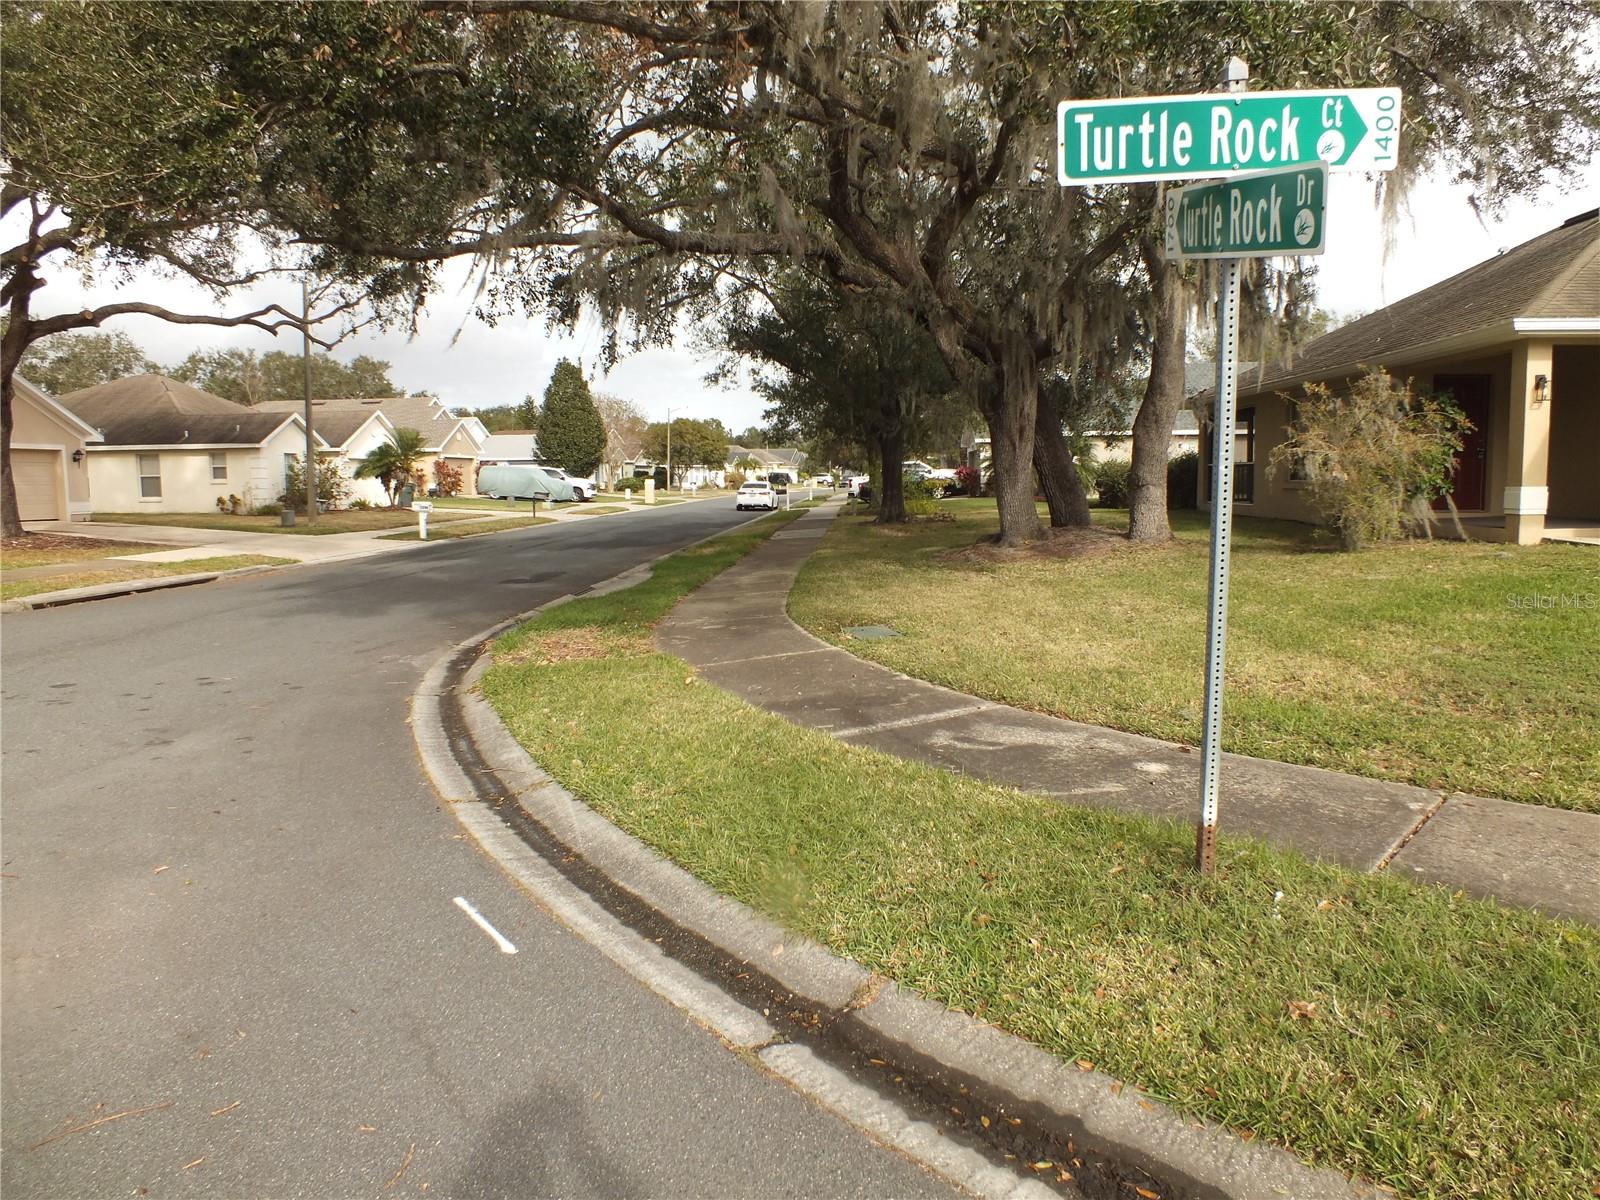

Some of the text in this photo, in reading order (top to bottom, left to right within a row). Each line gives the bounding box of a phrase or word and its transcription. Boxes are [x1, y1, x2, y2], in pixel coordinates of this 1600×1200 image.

[1074, 97, 1344, 172] Turtle Rock Ct
[1374, 95, 1395, 162] 1400
[1167, 197, 1175, 252] 1700
[1182, 173, 1315, 248] Turtle Rock Dr
